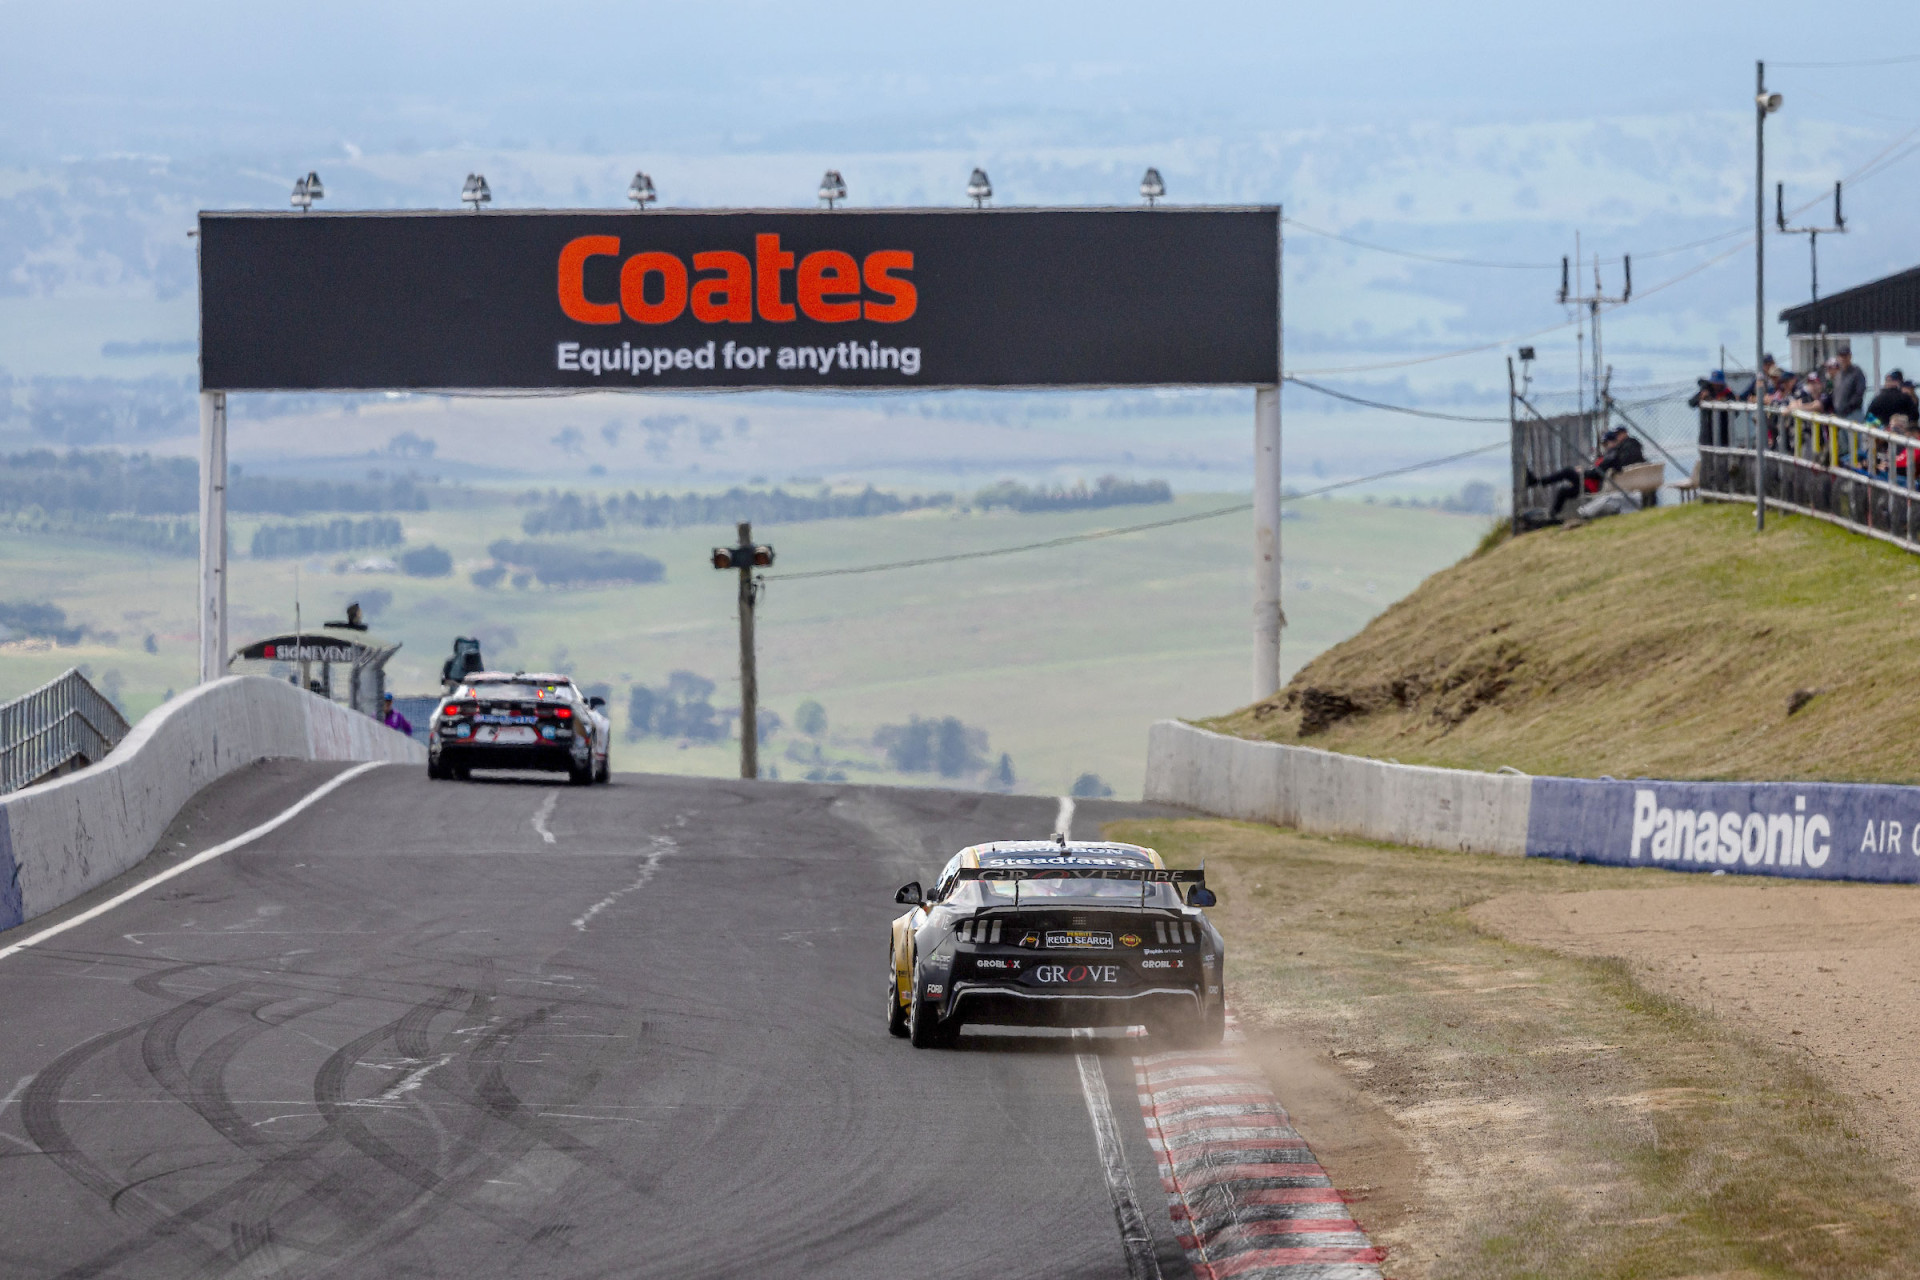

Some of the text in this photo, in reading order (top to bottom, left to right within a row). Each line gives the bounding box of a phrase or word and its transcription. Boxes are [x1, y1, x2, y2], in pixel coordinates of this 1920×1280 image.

[558, 233, 917, 324] Coates
[557, 340, 921, 376] Equipped for anything
[1630, 789, 1831, 869] Panasonic
[1860, 819, 1903, 855] AIR
[989, 856, 1117, 869] Steadfast
[1130, 870, 1184, 882] HIRE
[1047, 936, 1073, 945] REGO
[1075, 936, 1112, 946] SEARCH
[1036, 965, 1117, 983] GROVE
[927, 983, 944, 994] FORD
